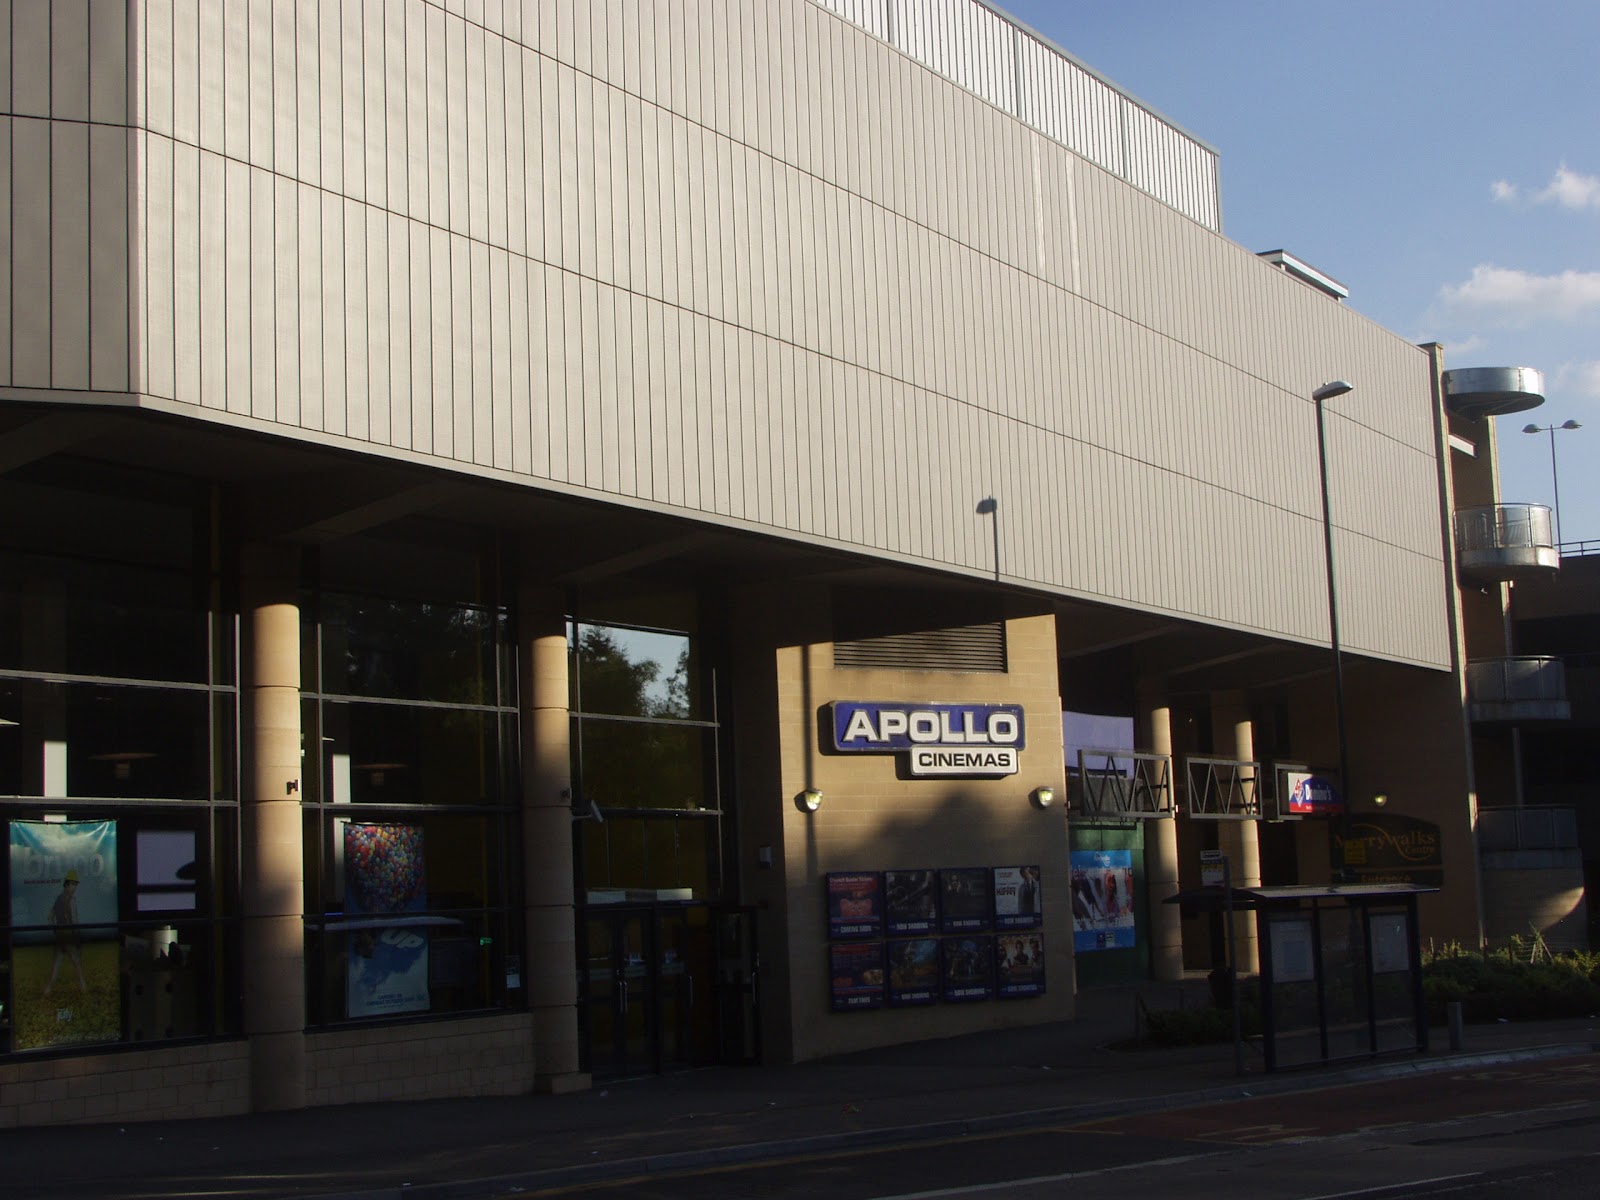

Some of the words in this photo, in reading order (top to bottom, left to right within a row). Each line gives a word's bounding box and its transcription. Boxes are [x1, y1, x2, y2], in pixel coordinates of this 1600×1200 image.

[843, 709, 1019, 744] APOLLO
[919, 753, 1011, 767] CINEMAS
[1335, 831, 1436, 849] Mrywalks
[381, 927, 425, 949] UP
